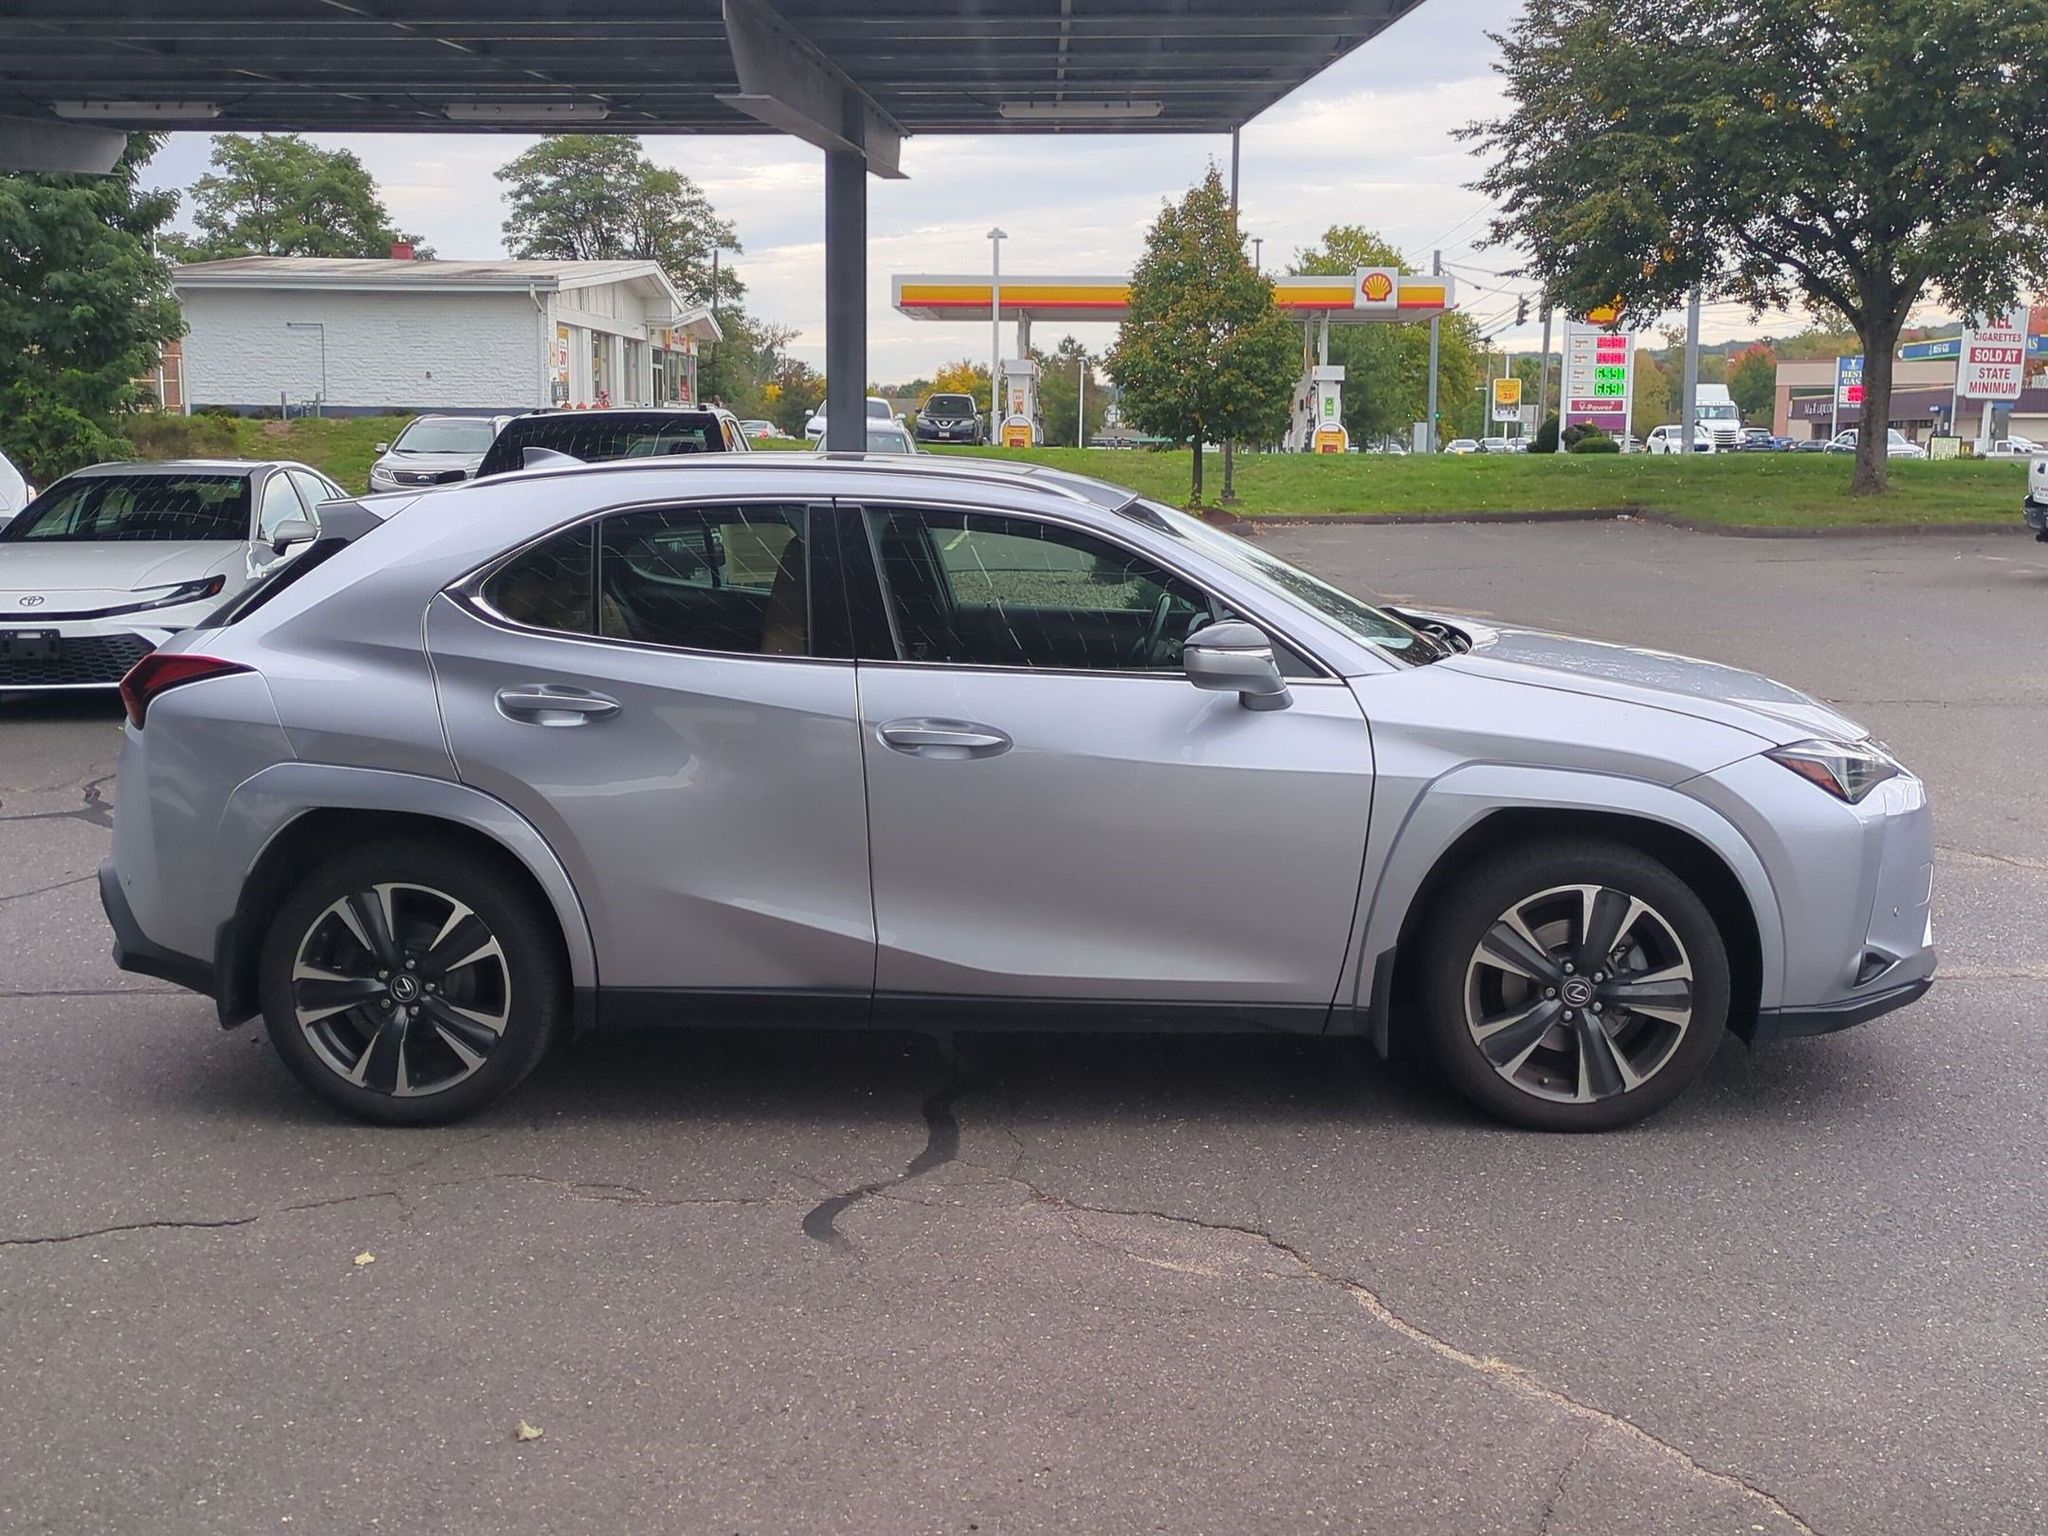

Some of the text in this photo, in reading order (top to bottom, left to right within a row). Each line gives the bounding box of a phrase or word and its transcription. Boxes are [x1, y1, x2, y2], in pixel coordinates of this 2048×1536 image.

[1974, 332, 2022, 343] CIGARETTES
[1974, 349, 2018, 362] SOLD AT
[1978, 367, 2011, 379] STATE
[1969, 381, 2017, 394] MINIMUM
